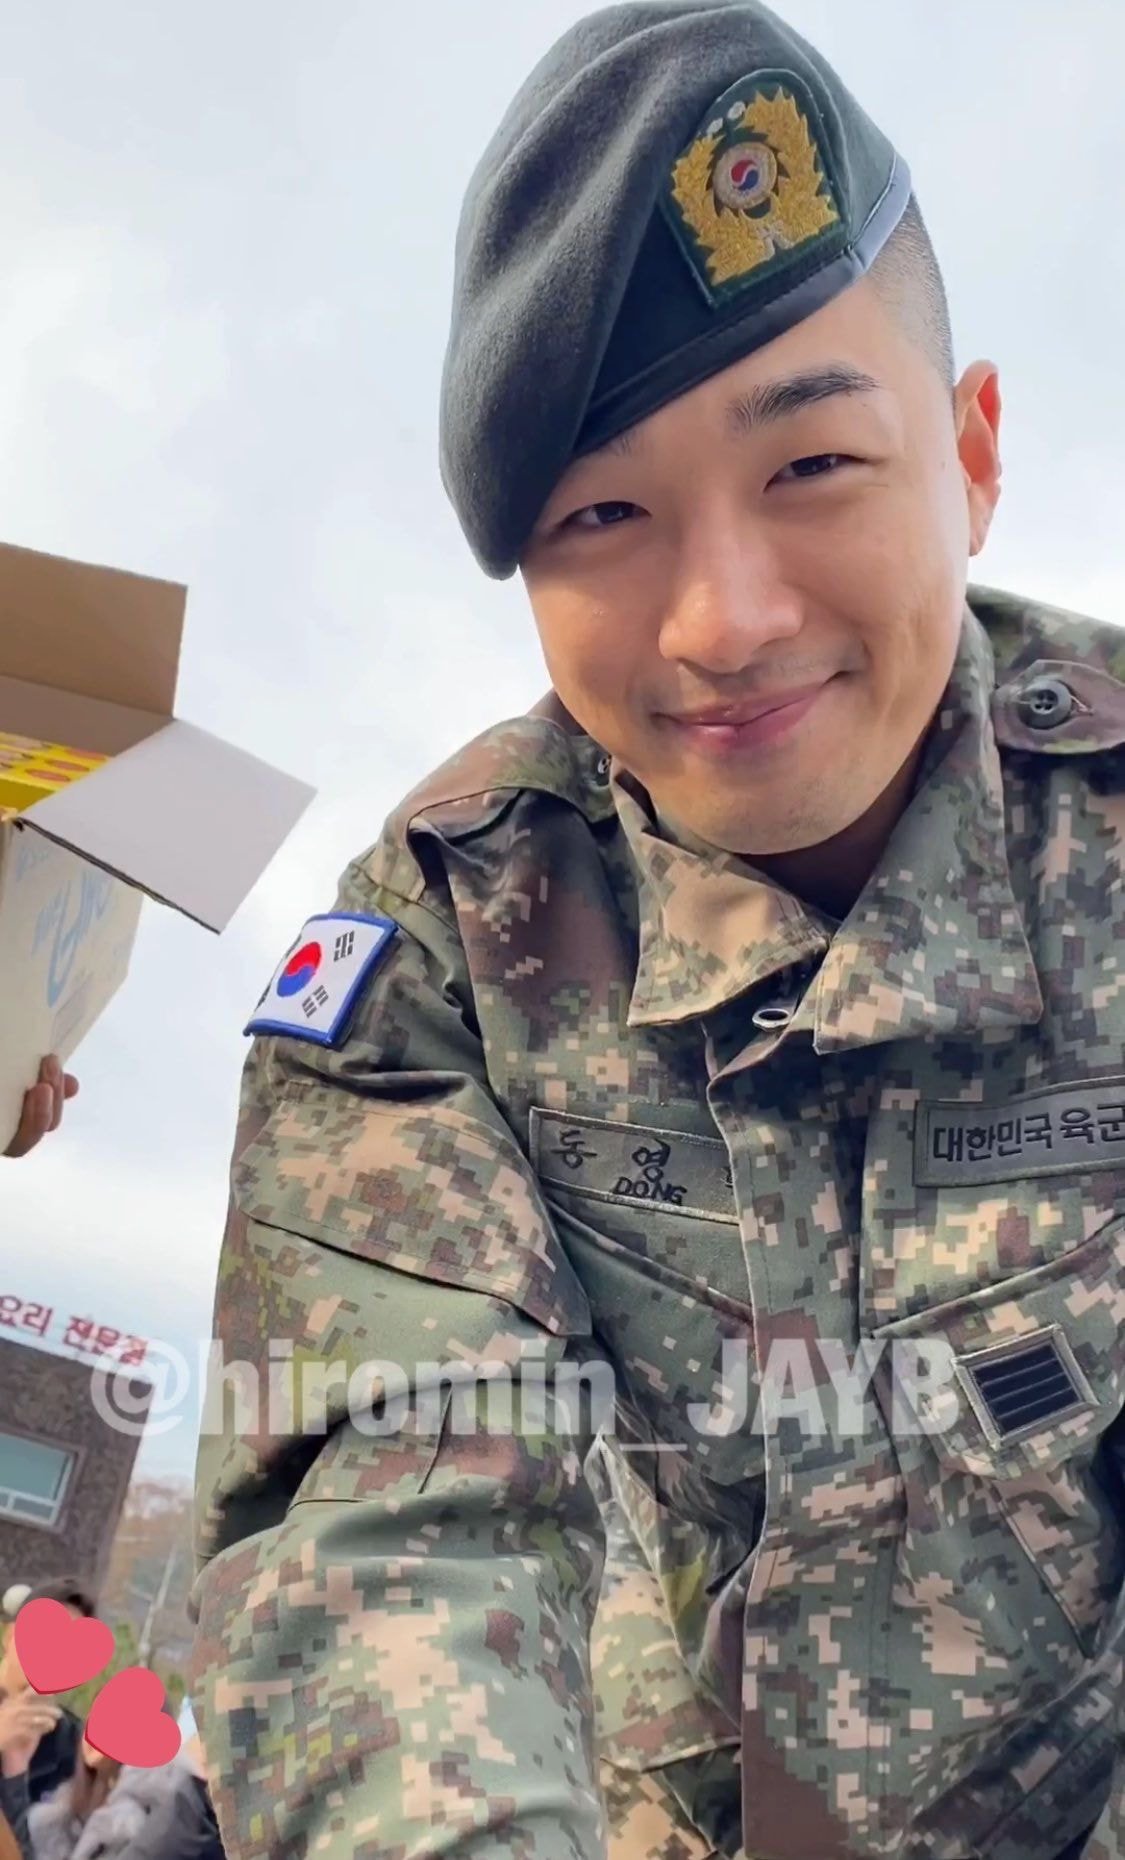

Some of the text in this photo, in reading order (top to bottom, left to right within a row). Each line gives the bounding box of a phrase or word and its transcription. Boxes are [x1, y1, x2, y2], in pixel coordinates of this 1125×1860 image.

[551, 1129, 598, 1169] 동
[631, 1138, 672, 1183] 영
[932, 1106, 1125, 1162] 대한민국 육군
[612, 1176, 688, 1206] DONG
[0, 1295, 53, 1336] 요리
